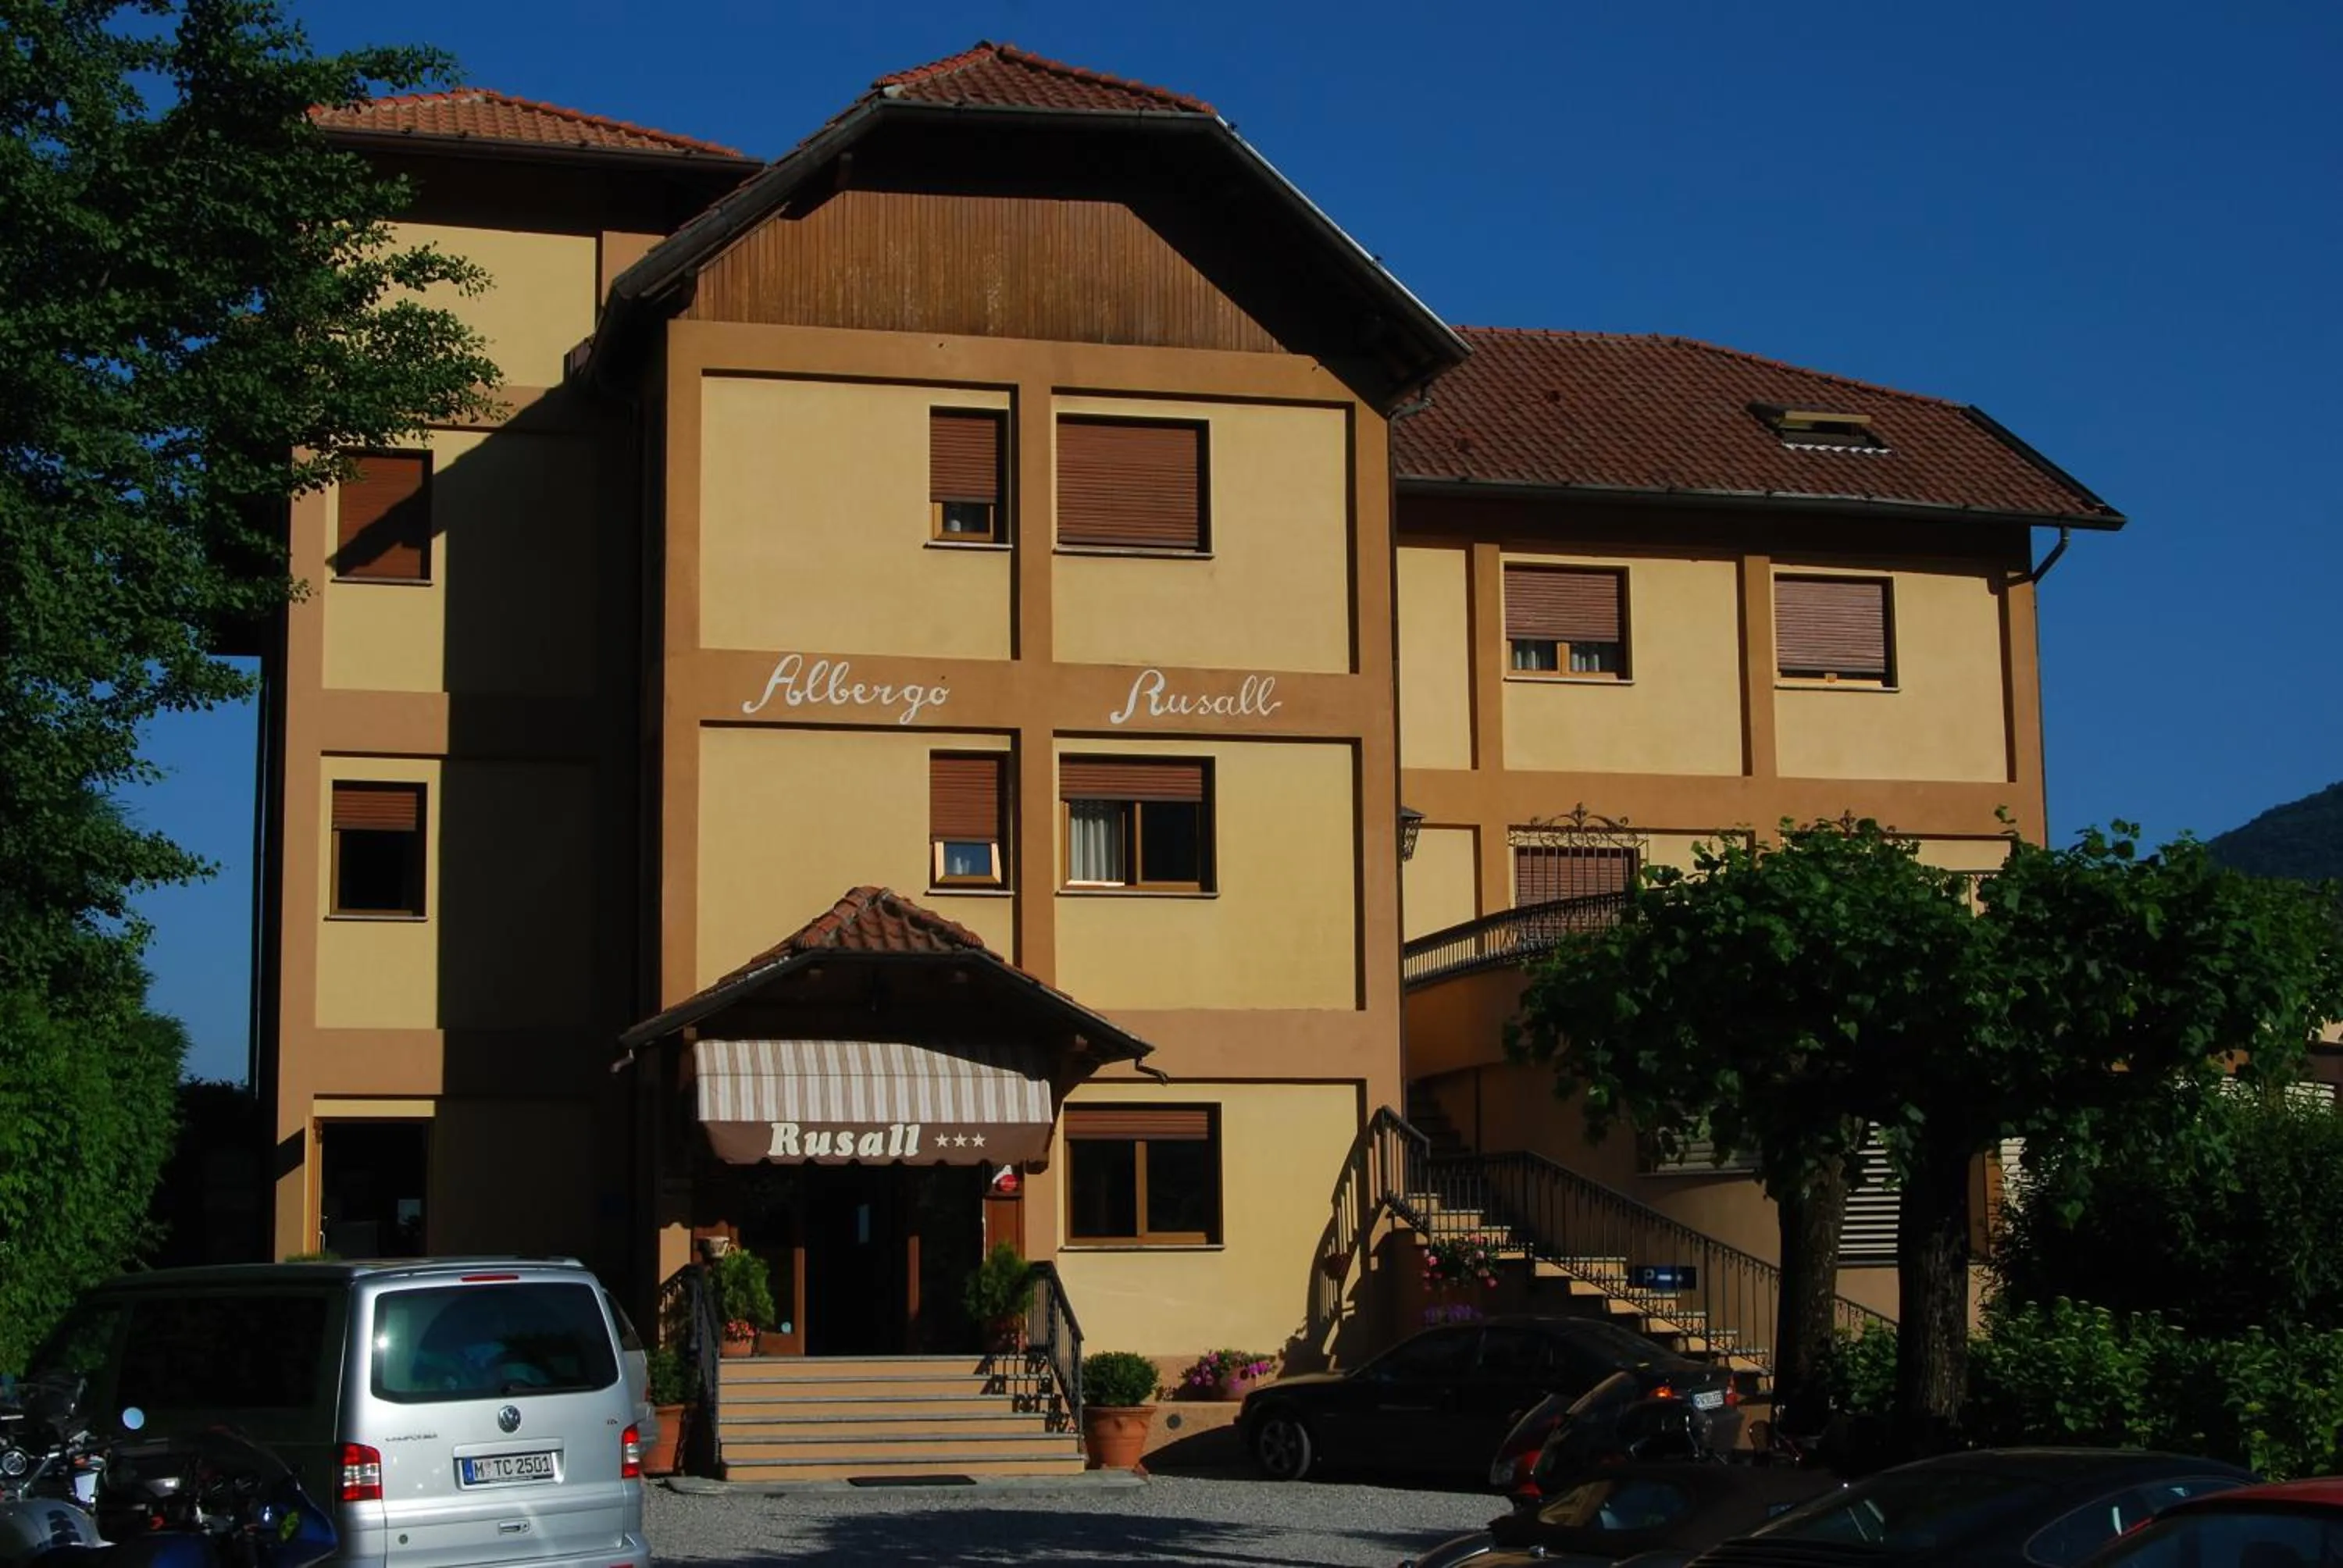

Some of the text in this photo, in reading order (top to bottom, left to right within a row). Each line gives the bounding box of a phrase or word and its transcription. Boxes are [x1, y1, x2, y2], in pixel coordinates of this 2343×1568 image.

[742, 654, 1283, 725] Albergo Rusall
[767, 1122, 921, 1156] Rusall
[494, 1459, 512, 1476] TC
[516, 1456, 551, 1474] 2501
